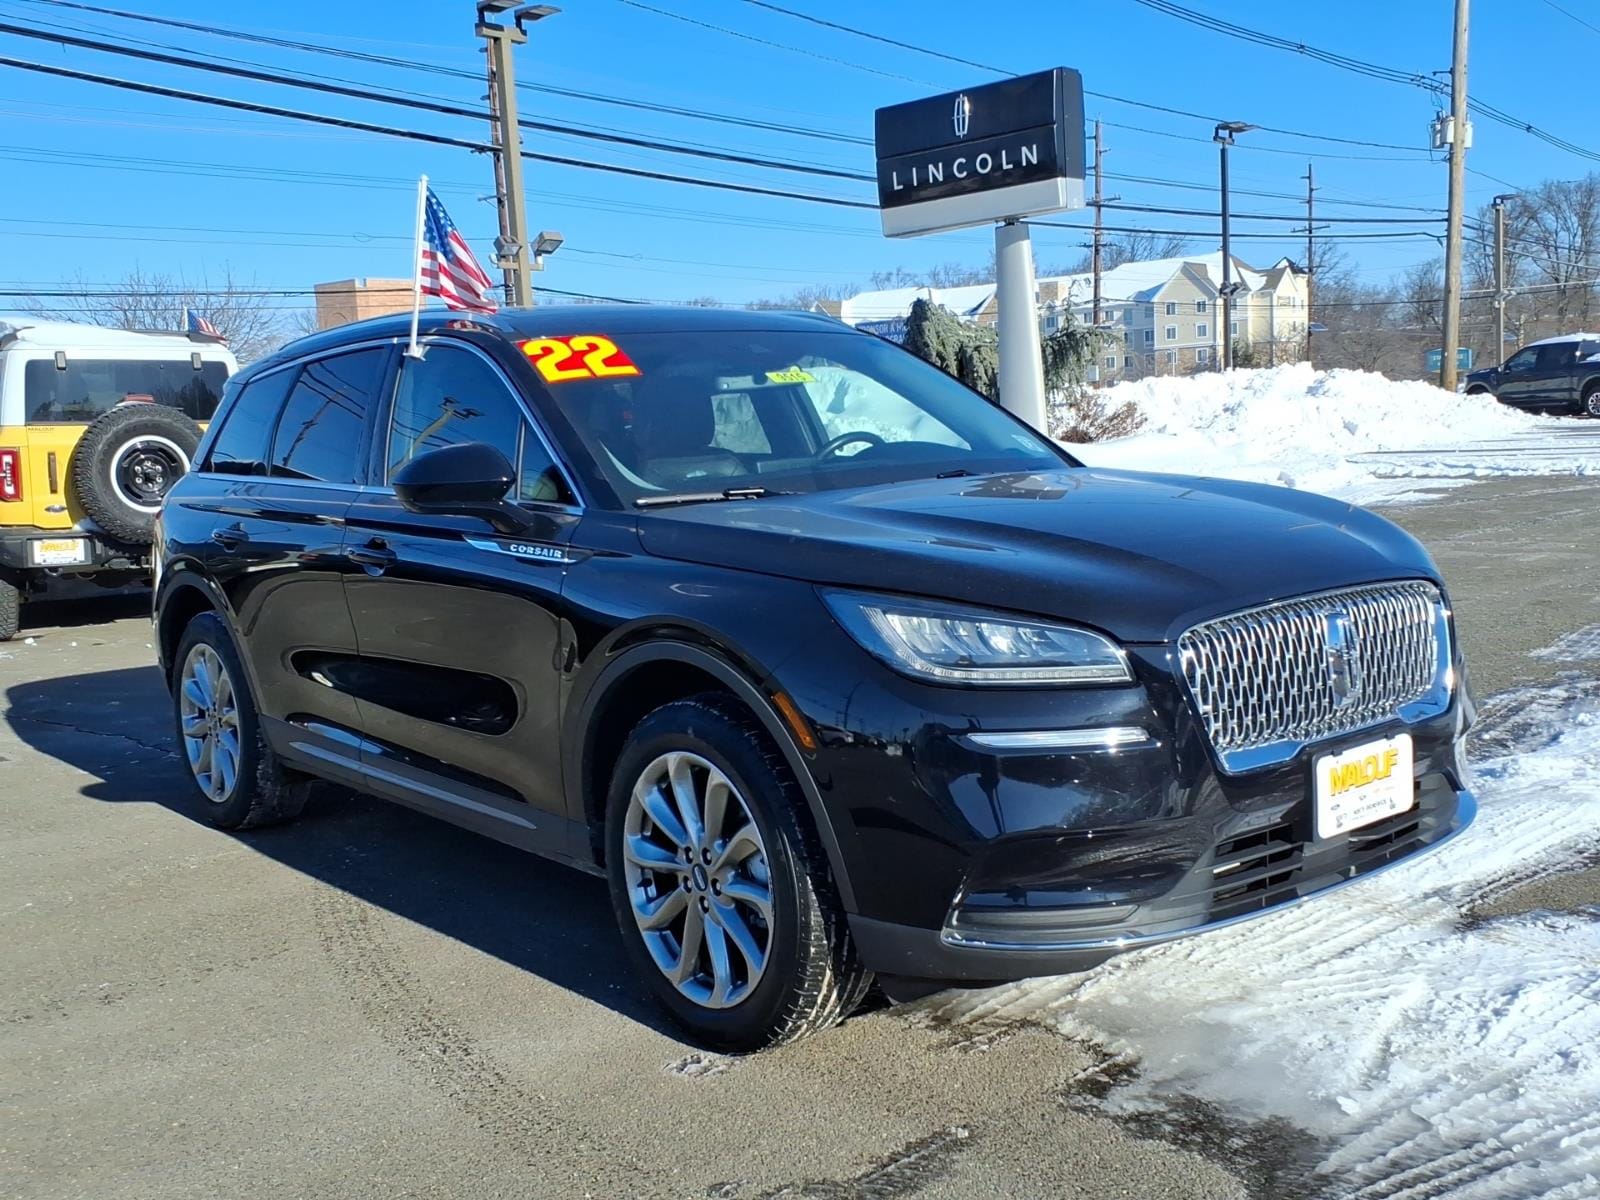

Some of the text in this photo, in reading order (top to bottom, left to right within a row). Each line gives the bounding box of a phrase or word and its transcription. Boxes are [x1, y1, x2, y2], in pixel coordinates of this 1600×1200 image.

[892, 144, 1038, 190] LINCOLN
[522, 336, 640, 382] 22
[510, 544, 562, 558] CORSAIR
[1330, 748, 1399, 796] MALOUF
